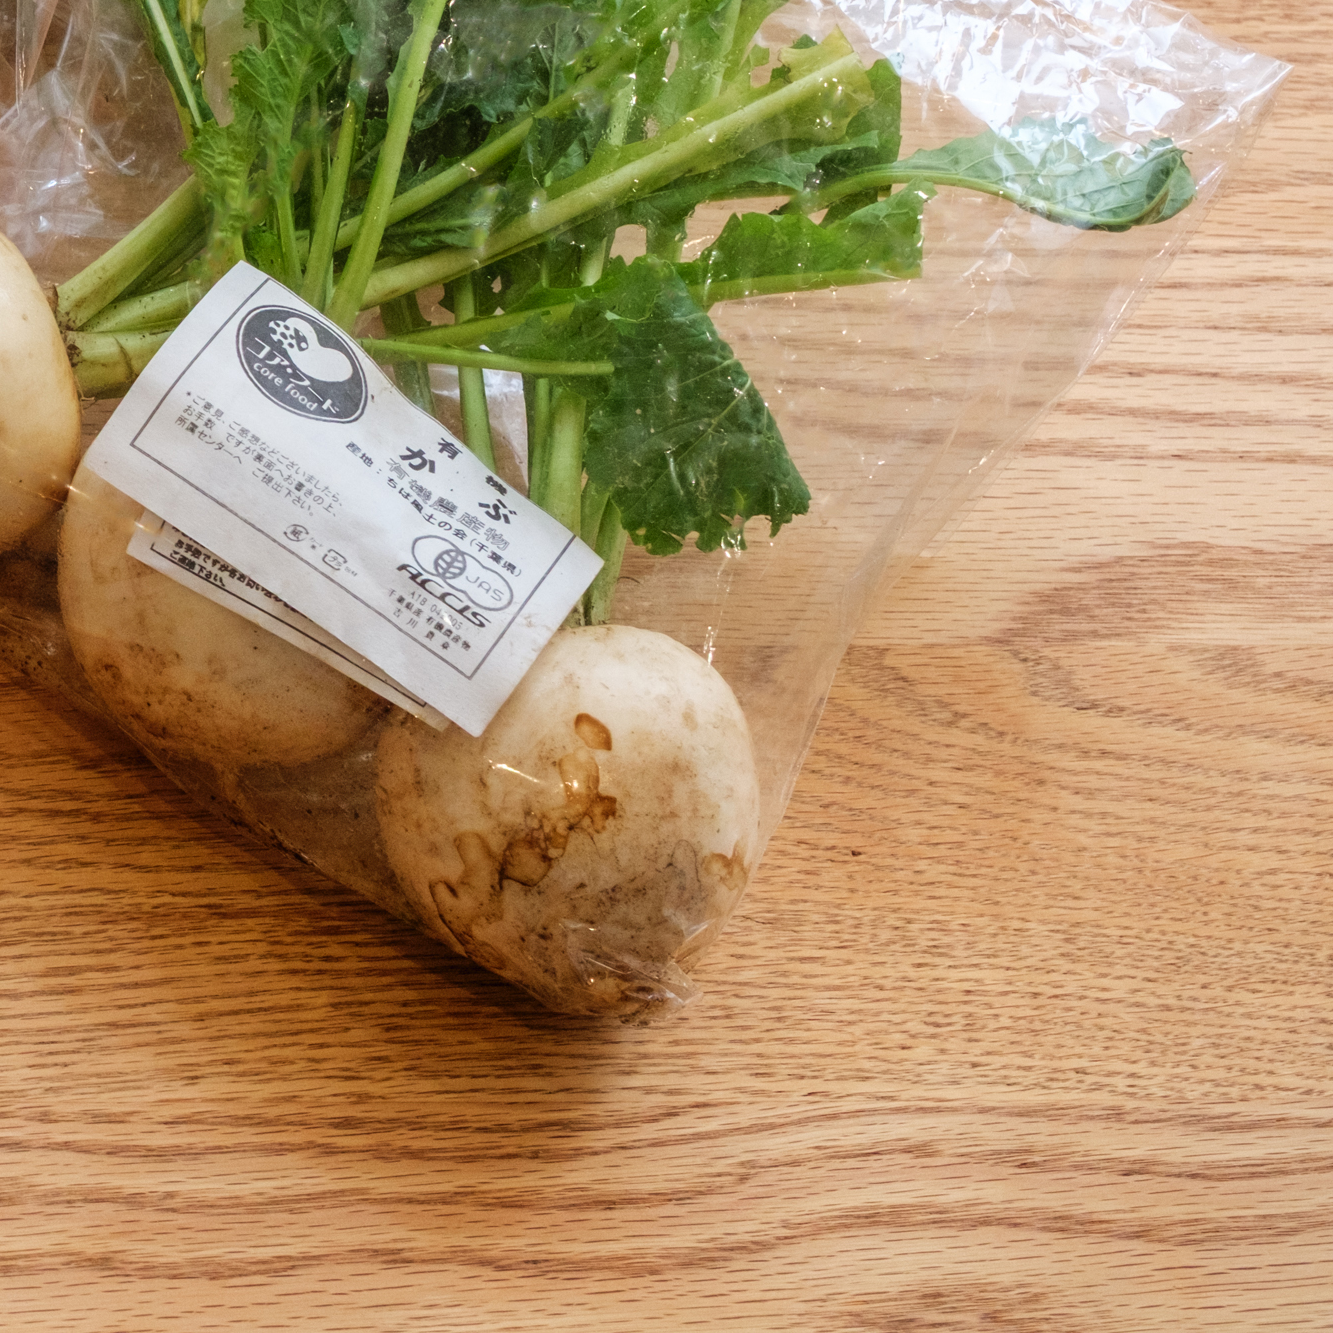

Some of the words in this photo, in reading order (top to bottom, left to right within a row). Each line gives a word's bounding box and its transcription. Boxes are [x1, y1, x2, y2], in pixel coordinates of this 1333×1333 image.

[246, 336, 340, 414] コア・フード
[251, 361, 284, 387] core
[283, 381, 318, 412] food
[383, 457, 512, 553] 有機農産物
[399, 447, 517, 524] かぶ
[395, 559, 493, 631] ACCIS
[466, 576, 504, 601] JAS
